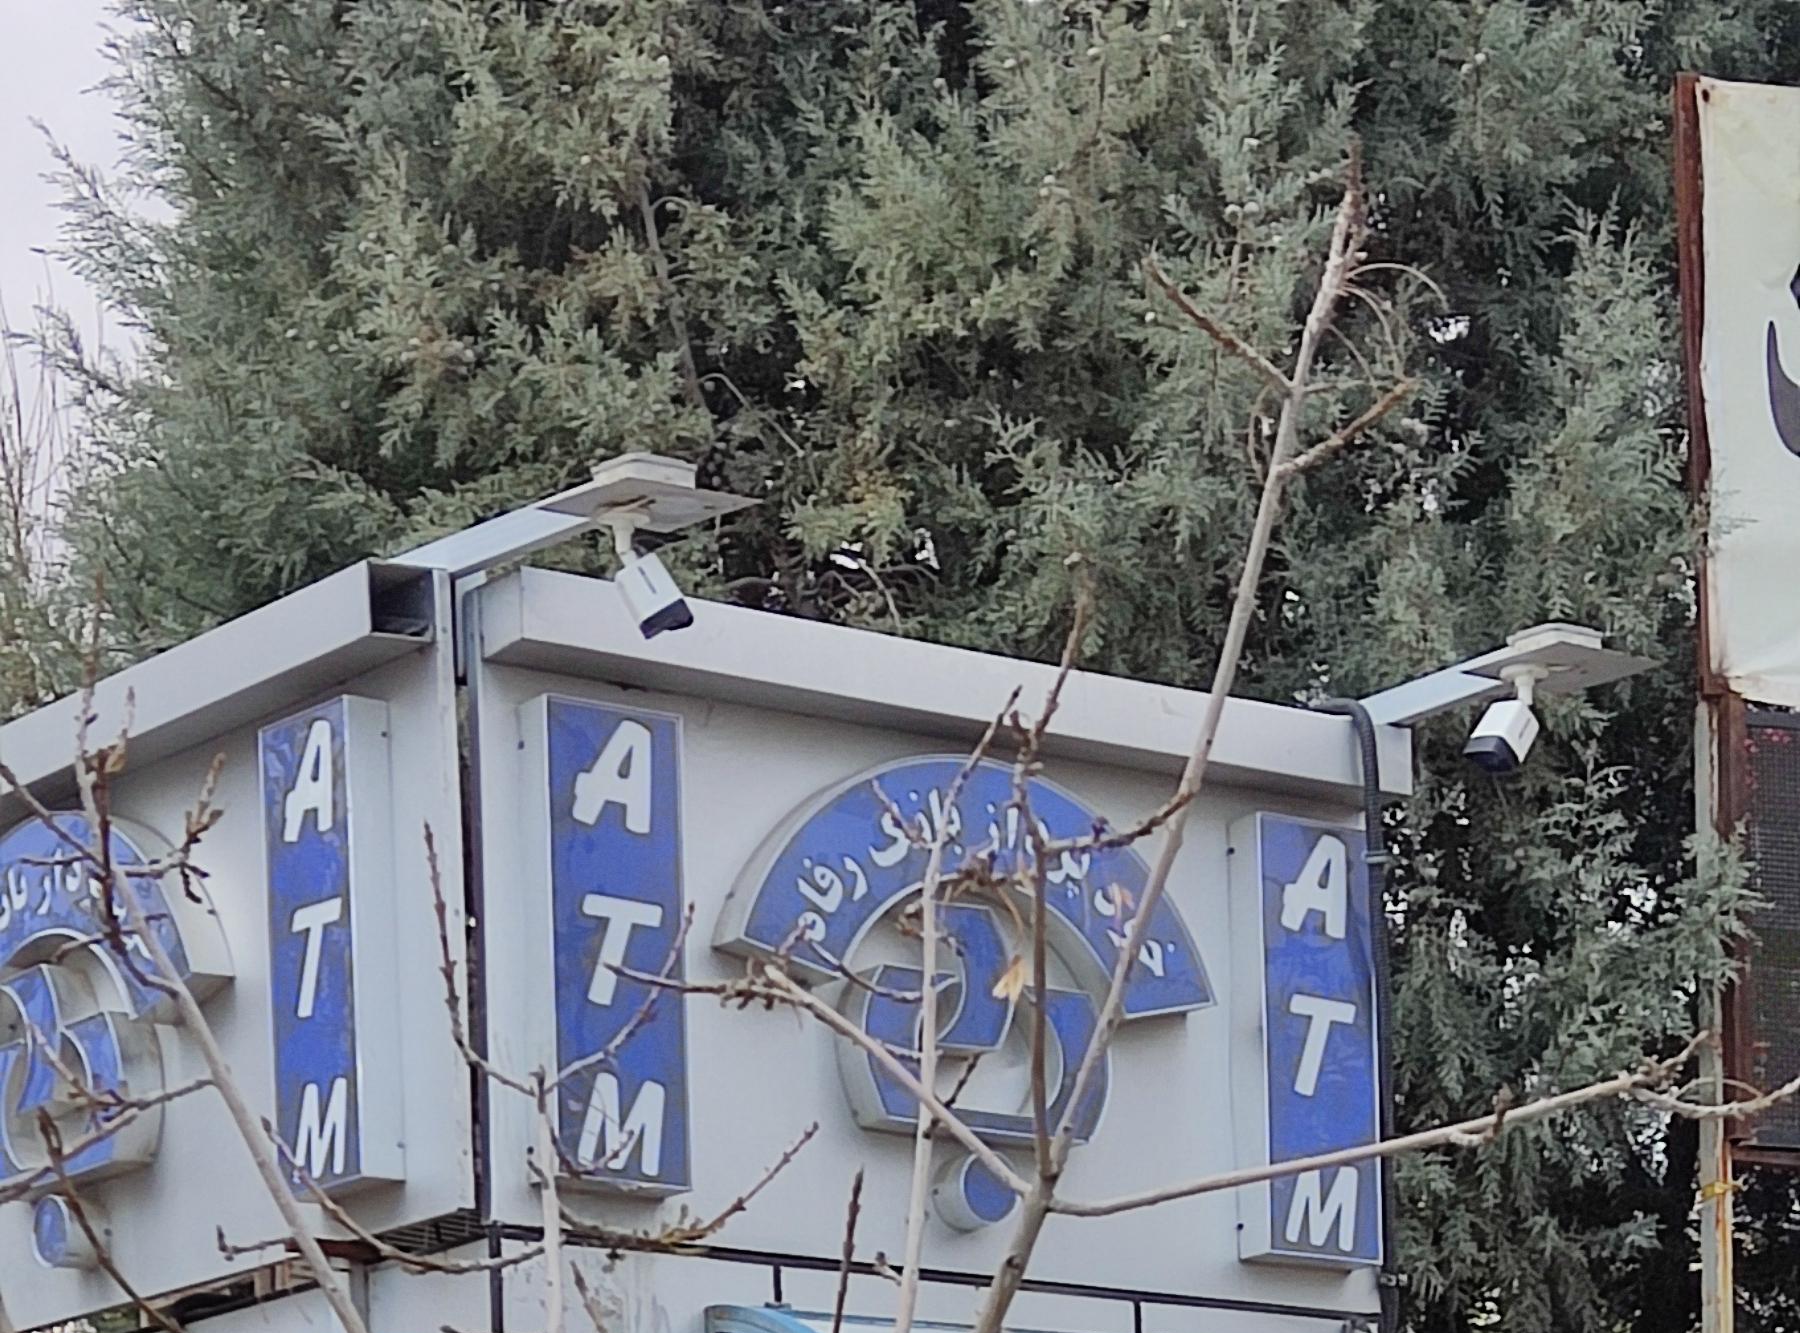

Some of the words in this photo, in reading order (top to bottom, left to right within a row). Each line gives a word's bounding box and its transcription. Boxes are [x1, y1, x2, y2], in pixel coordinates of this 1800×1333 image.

[283, 718, 348, 1182] ATM
[572, 719, 666, 1177] ATM
[797, 856, 868, 943] رفاه
[1281, 834, 1358, 1252] ATM
